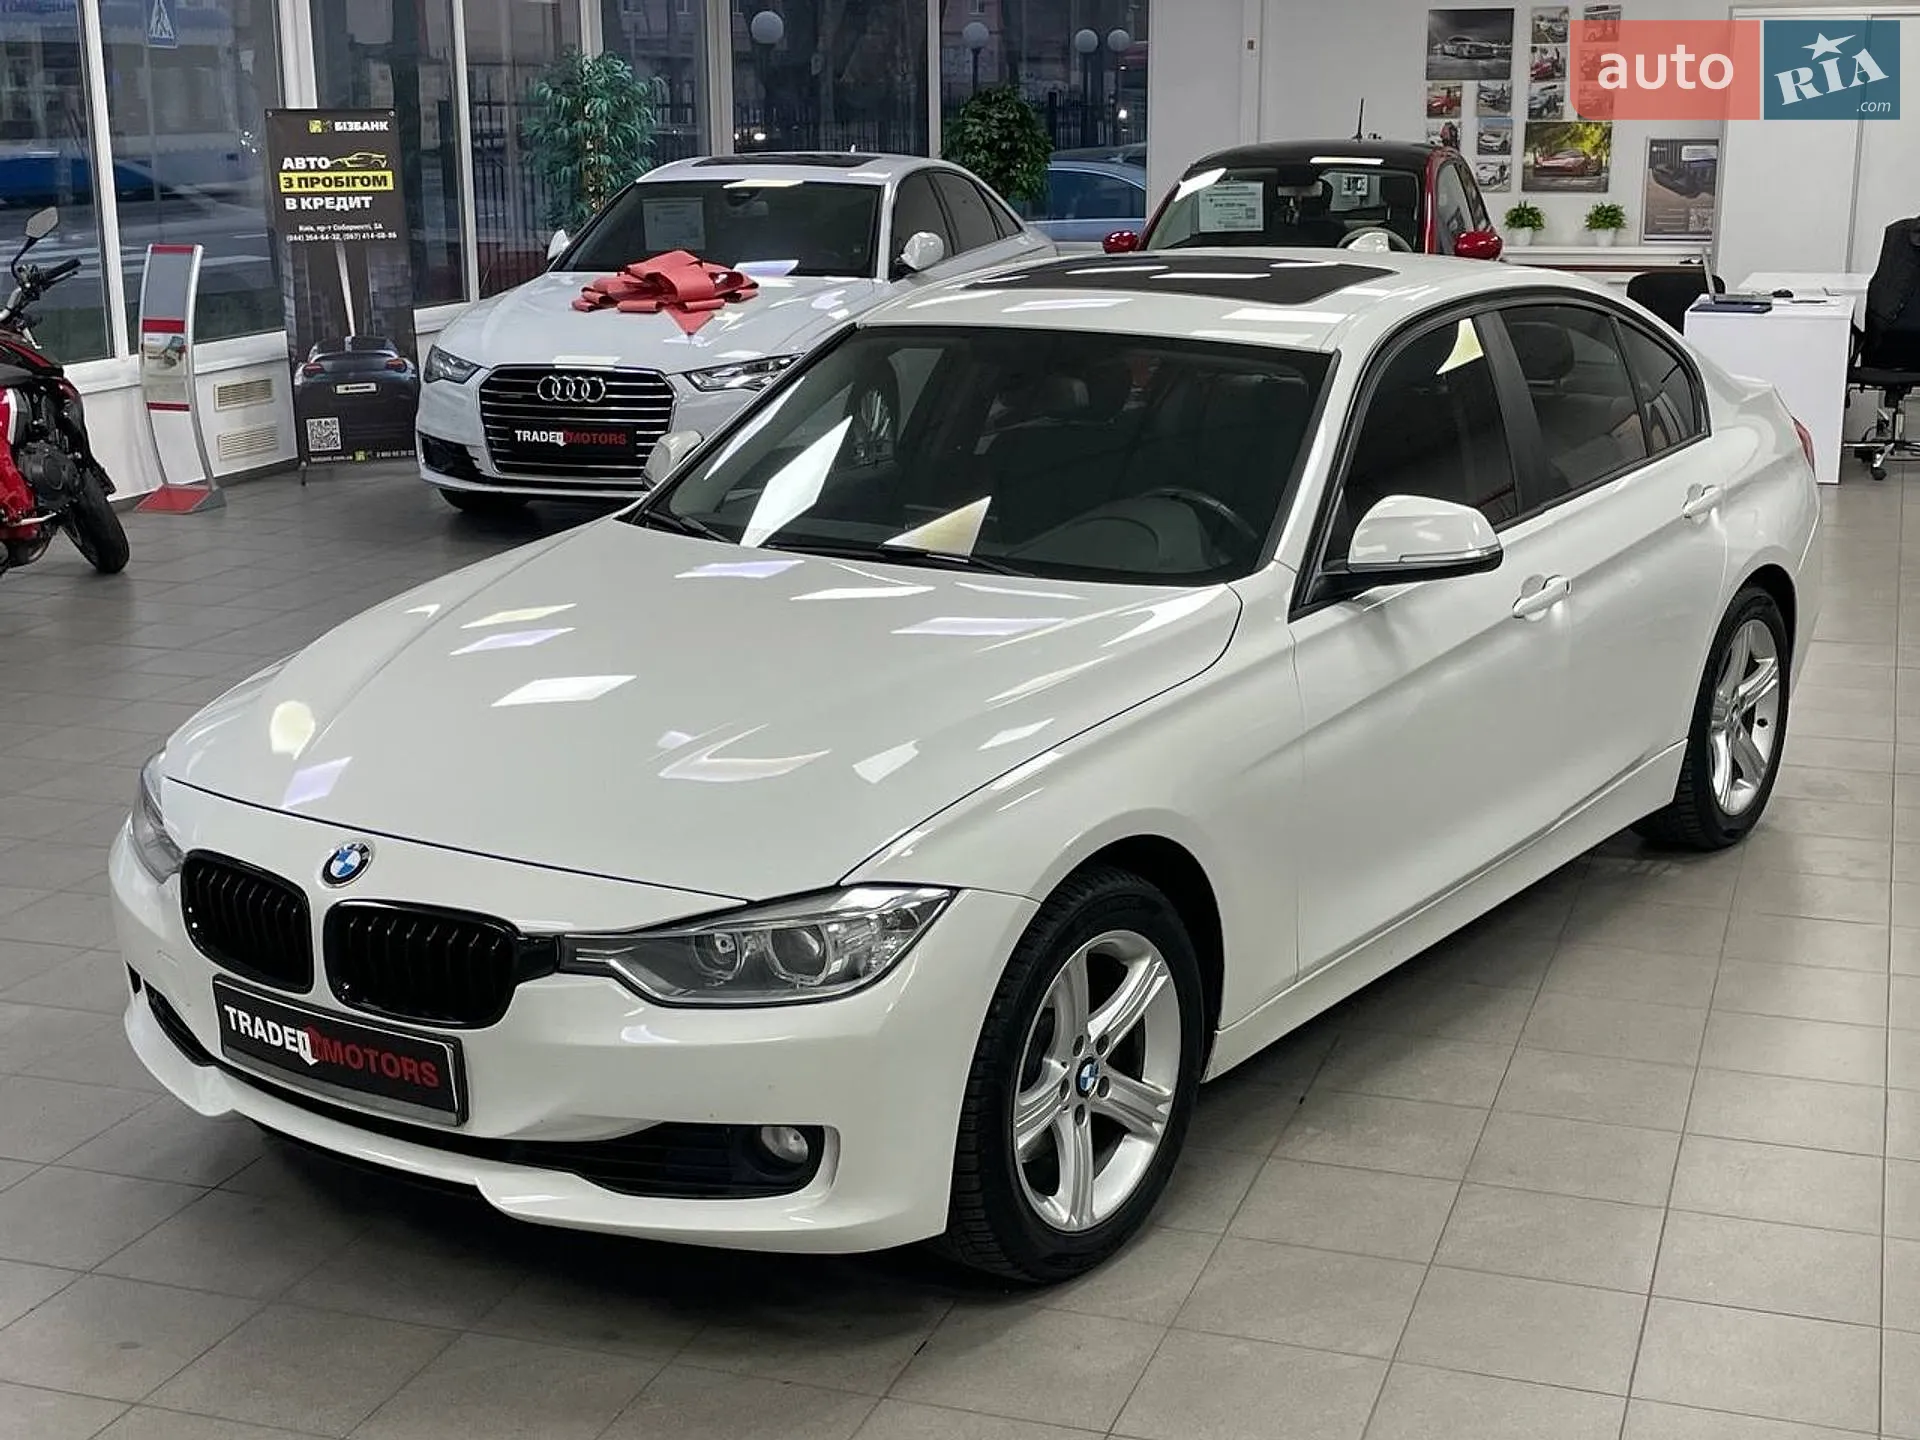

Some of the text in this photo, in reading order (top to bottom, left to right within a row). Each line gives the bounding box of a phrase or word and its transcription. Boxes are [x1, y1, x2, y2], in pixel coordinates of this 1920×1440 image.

[334, 120, 389, 132] БІЗБАНК
[282, 156, 331, 170] АВТО
[283, 174, 388, 188] З ПРОБІГОМ
[285, 196, 373, 211] В КРЕДИТ
